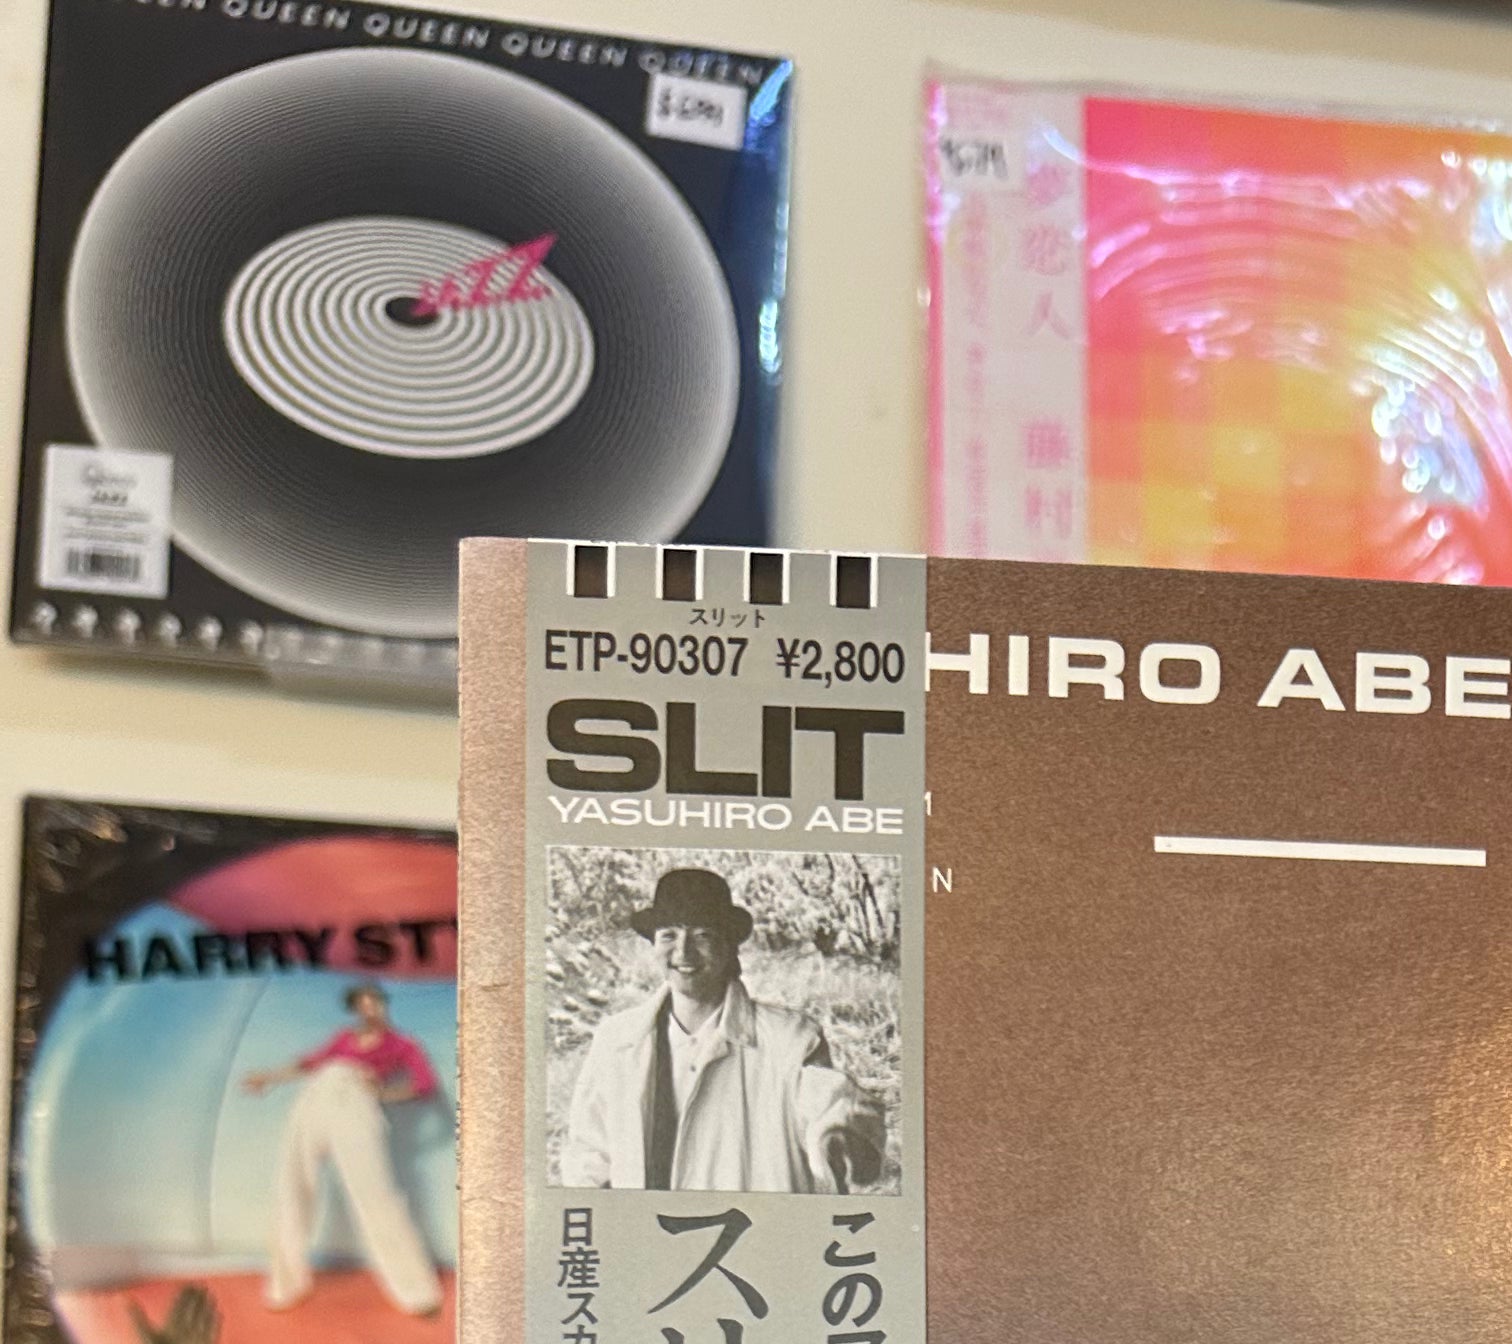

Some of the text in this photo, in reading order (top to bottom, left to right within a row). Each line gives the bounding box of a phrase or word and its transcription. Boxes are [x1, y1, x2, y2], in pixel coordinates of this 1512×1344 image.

[363, 12, 490, 49] QUEEN
[501, 31, 629, 67] QUEEN
[689, 607, 766, 629] スリット
[545, 629, 905, 688] ETP-90307 ¥2,800
[925, 631, 1221, 705] HIRO
[1257, 648, 1512, 720] ABE
[546, 698, 905, 801] SLIT
[548, 796, 904, 835] YASUHIRO ABE
[81, 917, 457, 985] HARRY ST
